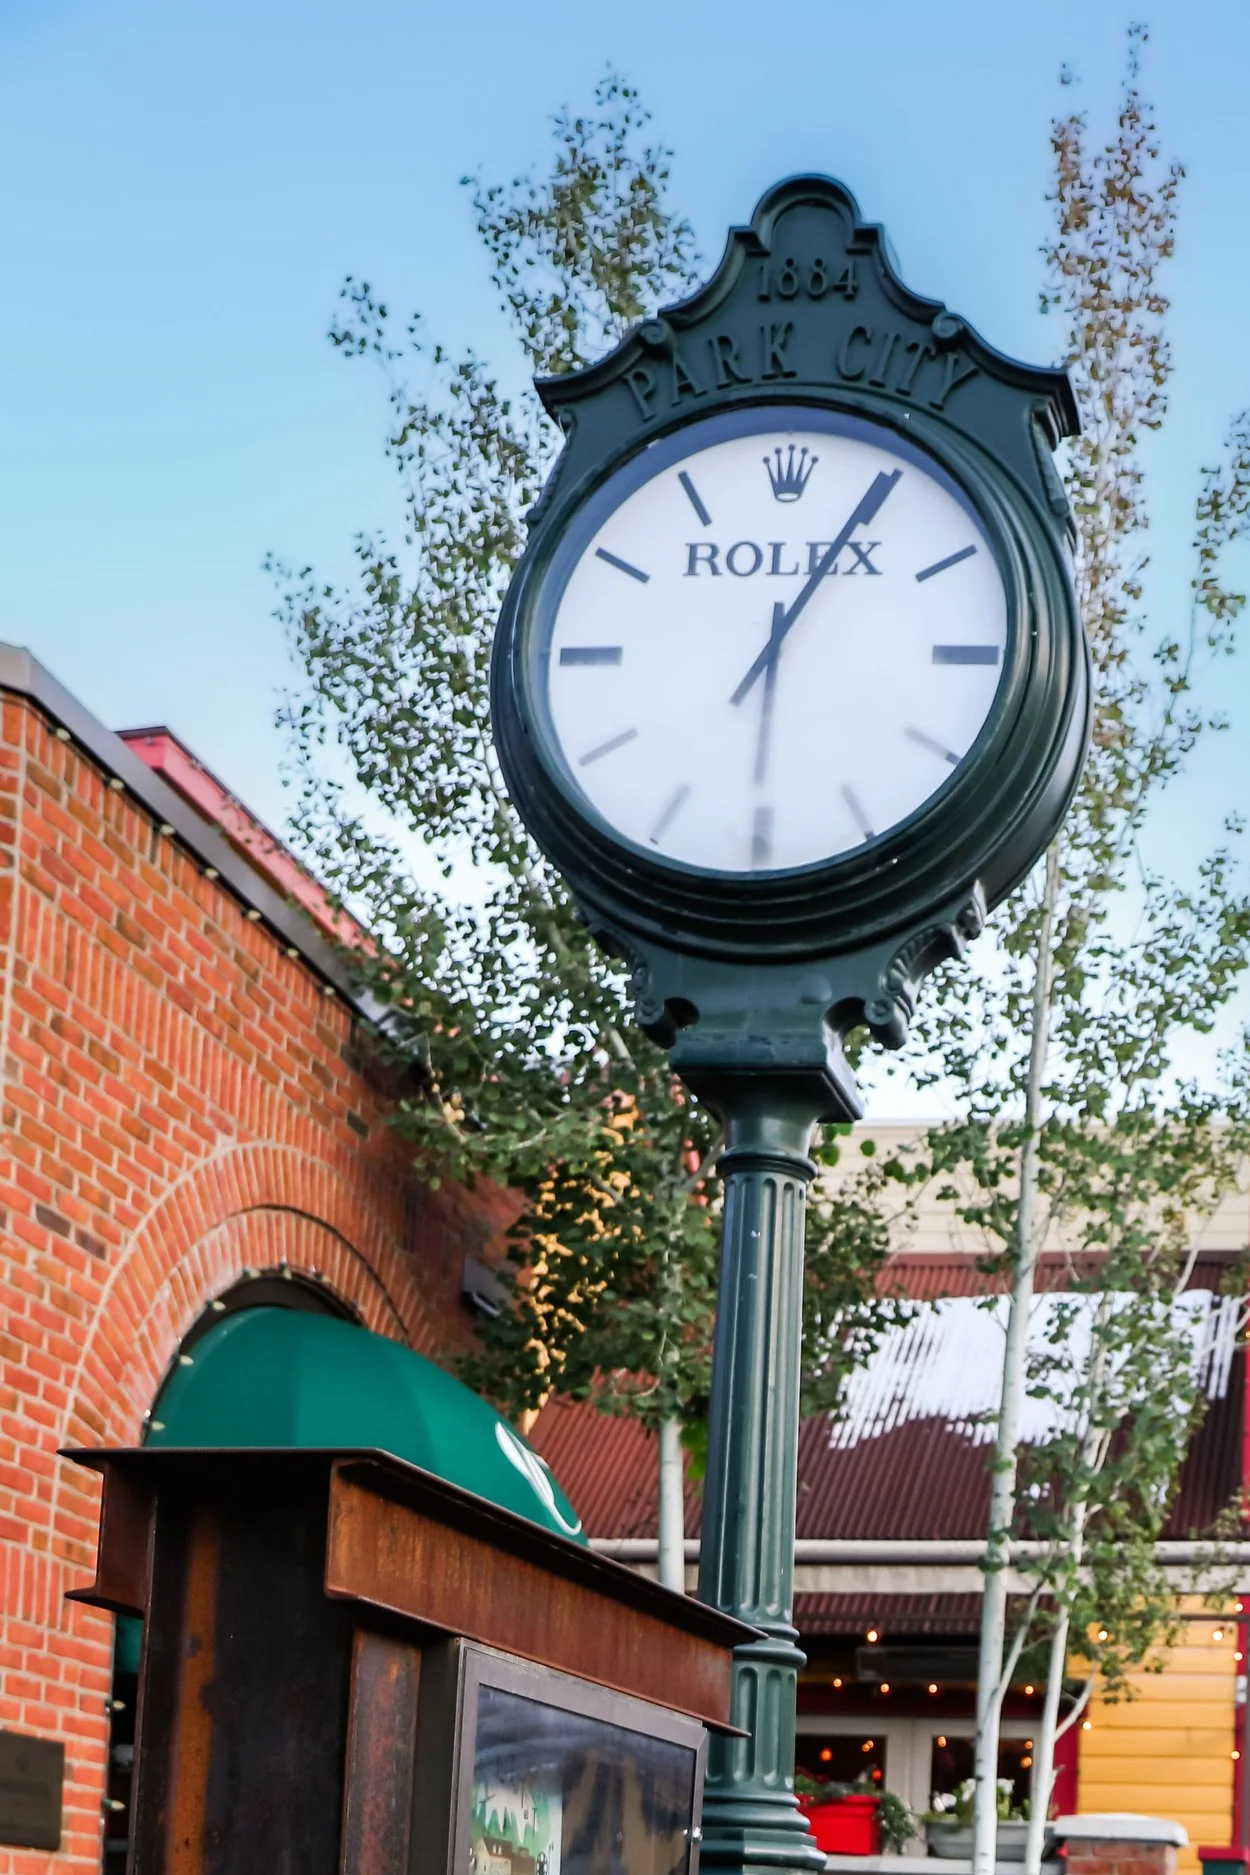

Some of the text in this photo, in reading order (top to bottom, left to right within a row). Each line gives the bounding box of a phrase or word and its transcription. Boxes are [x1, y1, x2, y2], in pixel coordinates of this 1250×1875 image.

[756, 257, 859, 301] 1884
[623, 321, 980, 422] PARK CITY
[683, 541, 882, 577] ROLEX
